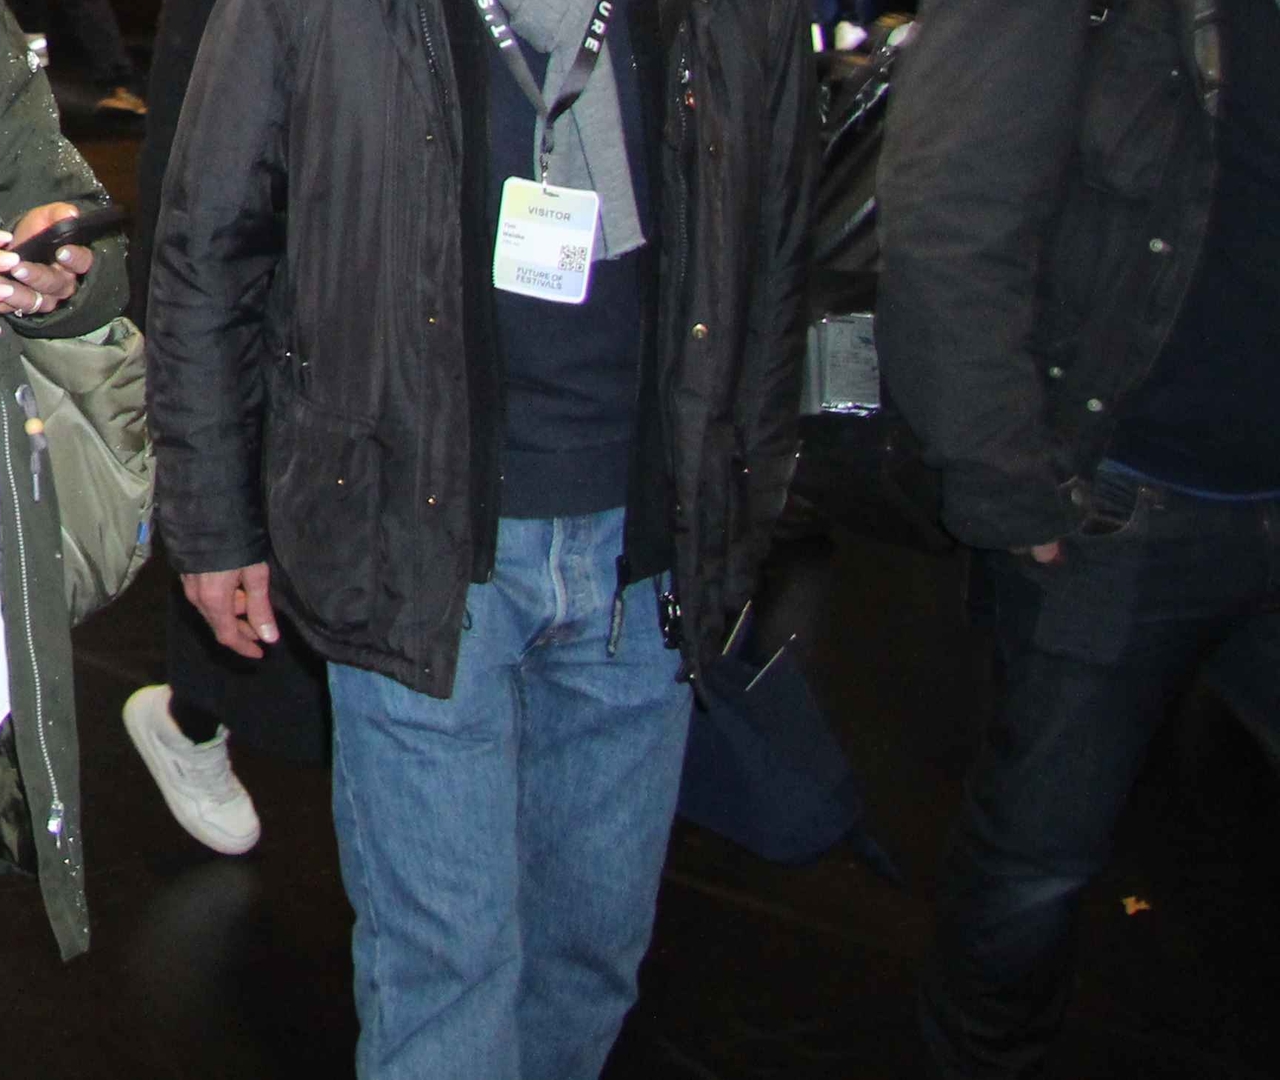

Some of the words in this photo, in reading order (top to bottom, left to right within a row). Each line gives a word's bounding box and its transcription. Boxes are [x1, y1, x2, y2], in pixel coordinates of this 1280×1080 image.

[528, 205, 571, 222] VISITOR
[515, 274, 563, 291] FESTIVALS
[516, 266, 549, 280] FUTURE
[551, 274, 563, 283] OF
